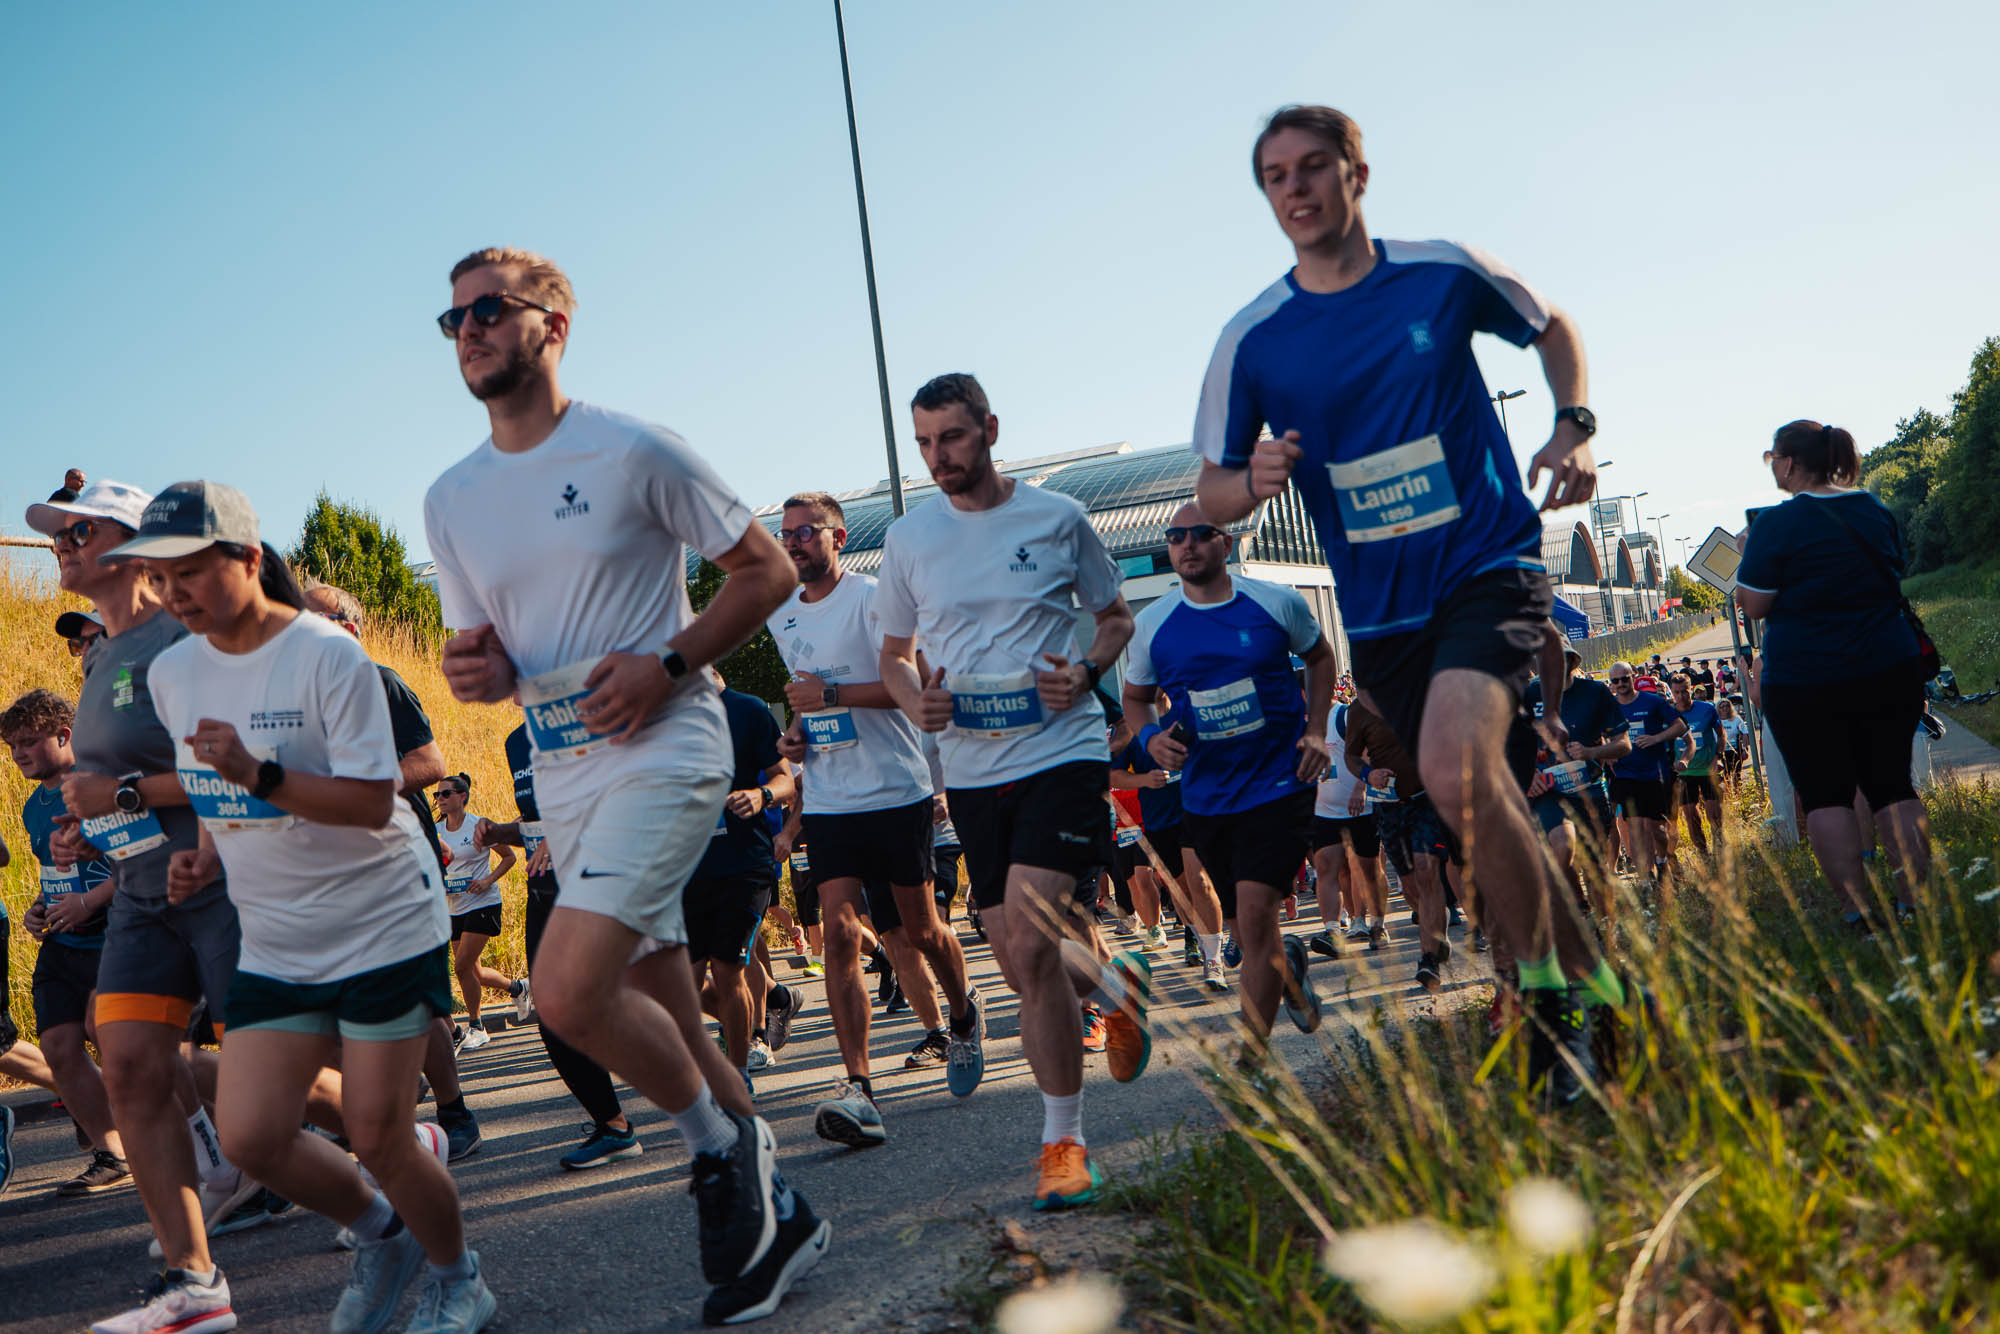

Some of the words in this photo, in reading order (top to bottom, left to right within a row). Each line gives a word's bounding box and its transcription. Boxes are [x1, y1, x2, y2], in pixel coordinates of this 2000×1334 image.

[1350, 474, 1431, 511] Laurin
[1008, 562, 1038, 573] VETTER
[958, 695, 1028, 714] Markus
[1198, 700, 1249, 722] Steven
[531, 700, 583, 730] Fabi
[808, 719, 840, 733] Georg
[217, 802, 248, 816] 3054
[43, 880, 73, 893] Marvin
